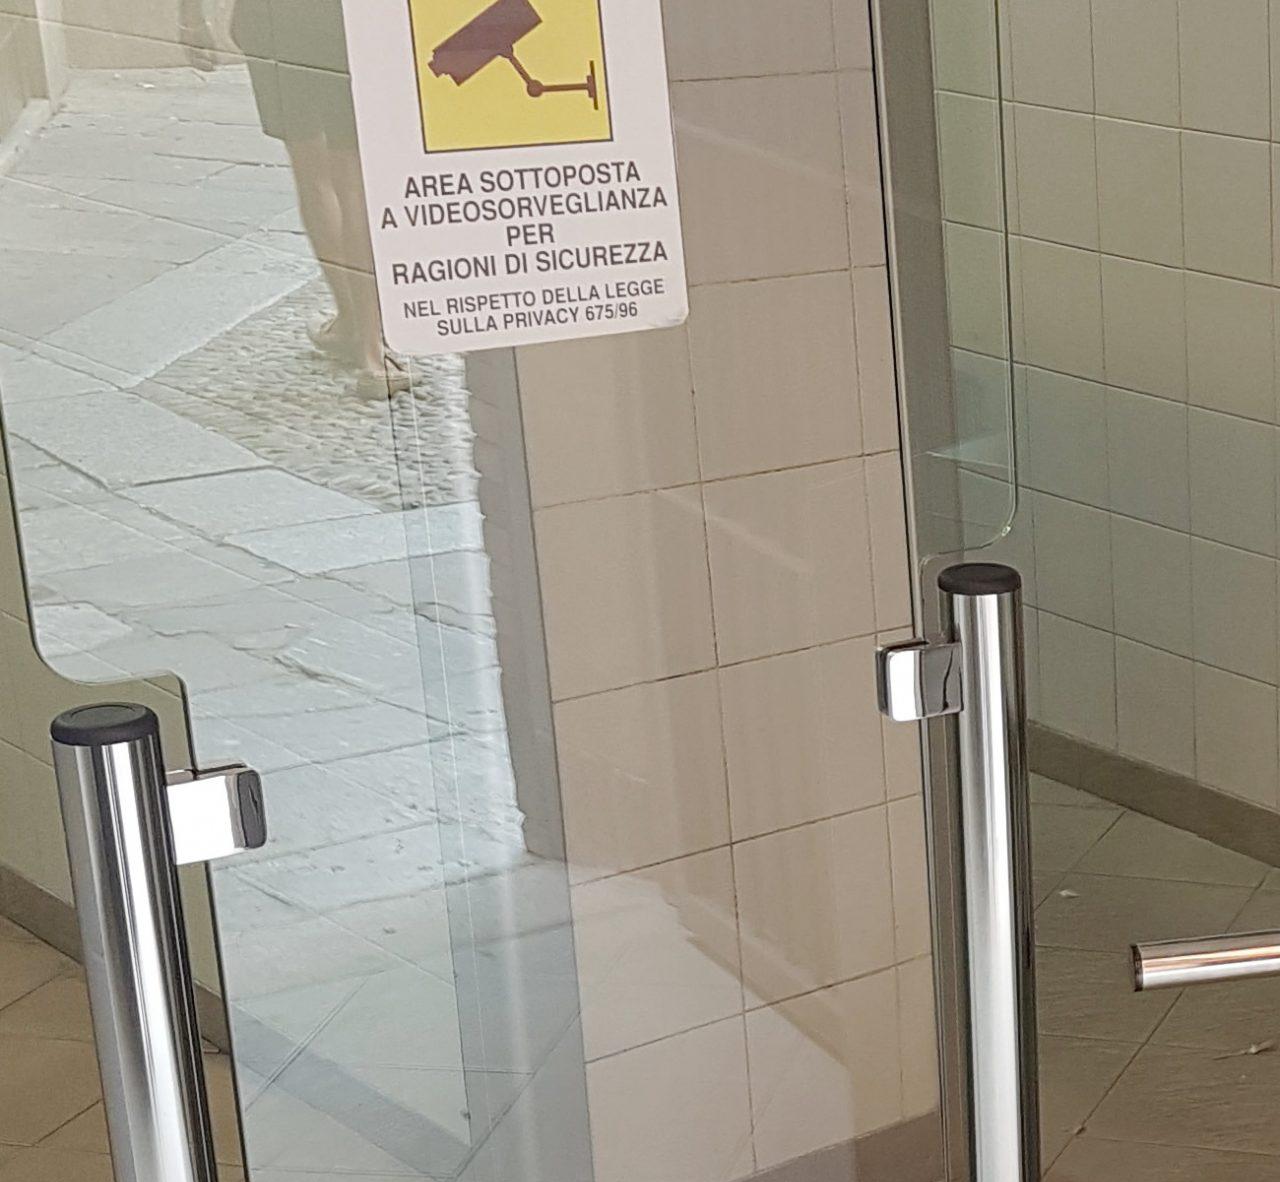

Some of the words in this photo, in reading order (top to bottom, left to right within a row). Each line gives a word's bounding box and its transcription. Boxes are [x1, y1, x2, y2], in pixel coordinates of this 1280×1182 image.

[404, 173, 473, 198] AREA
[480, 161, 641, 193] SOTTOPOSTA
[381, 208, 398, 229] A
[404, 186, 668, 227] VIDEOSORVEGLIANZA
[506, 223, 555, 246] PER
[392, 255, 496, 285] RAGIONI
[505, 253, 528, 275] DI
[536, 241, 668, 271] SICUREZZA
[404, 299, 441, 318] NEL
[446, 290, 536, 315] RISPETTO
[542, 284, 600, 305] DELLA
[605, 279, 665, 299] LEGGE
[437, 315, 498, 336] SULLA
[503, 307, 579, 330] PRIVACY
[585, 301, 639, 321] 675/96
